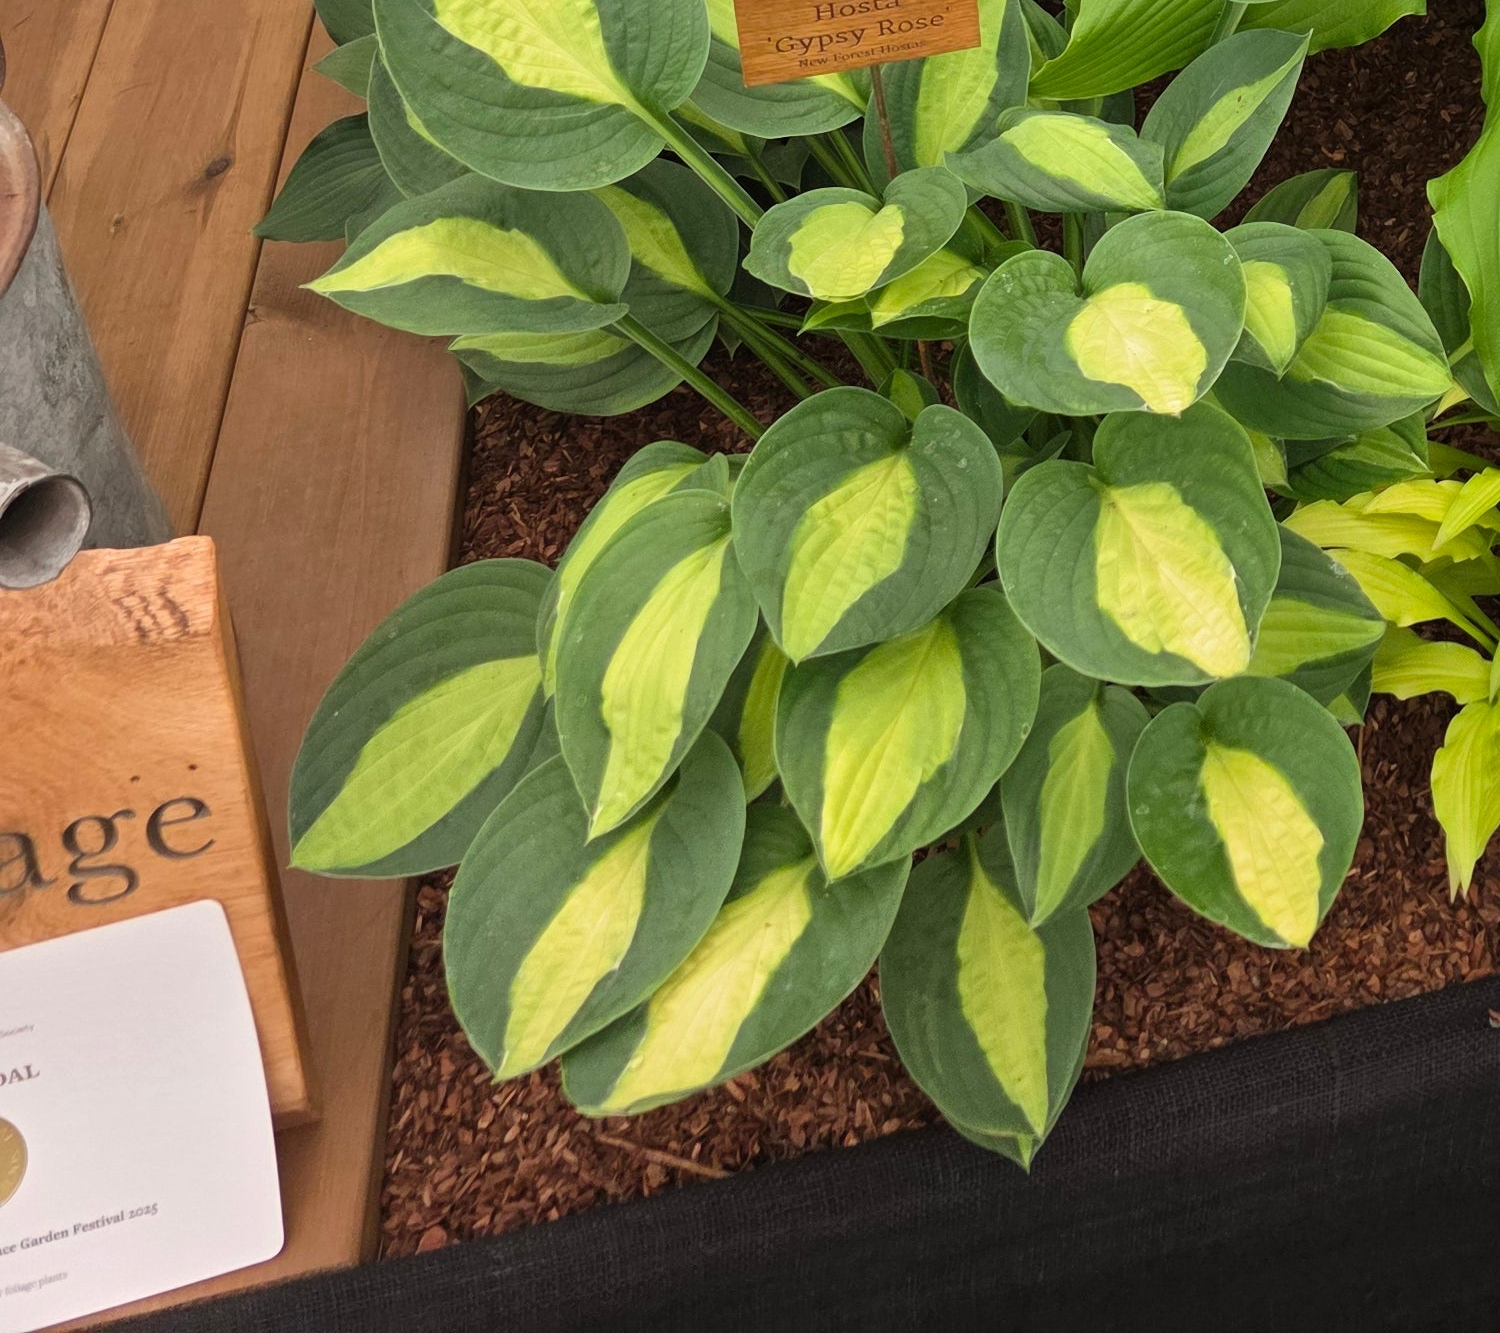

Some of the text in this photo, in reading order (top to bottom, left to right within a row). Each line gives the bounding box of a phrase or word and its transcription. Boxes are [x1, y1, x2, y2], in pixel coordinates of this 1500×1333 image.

[767, 6, 950, 56] 'Gypsy Rose'
[799, 57, 829, 68] New
[833, 47, 877, 62] Forest
[0, 796, 217, 907] age
[20, 1230, 69, 1250] Garden
[73, 1210, 125, 1235] Festival
[129, 1203, 158, 1220] 2025
